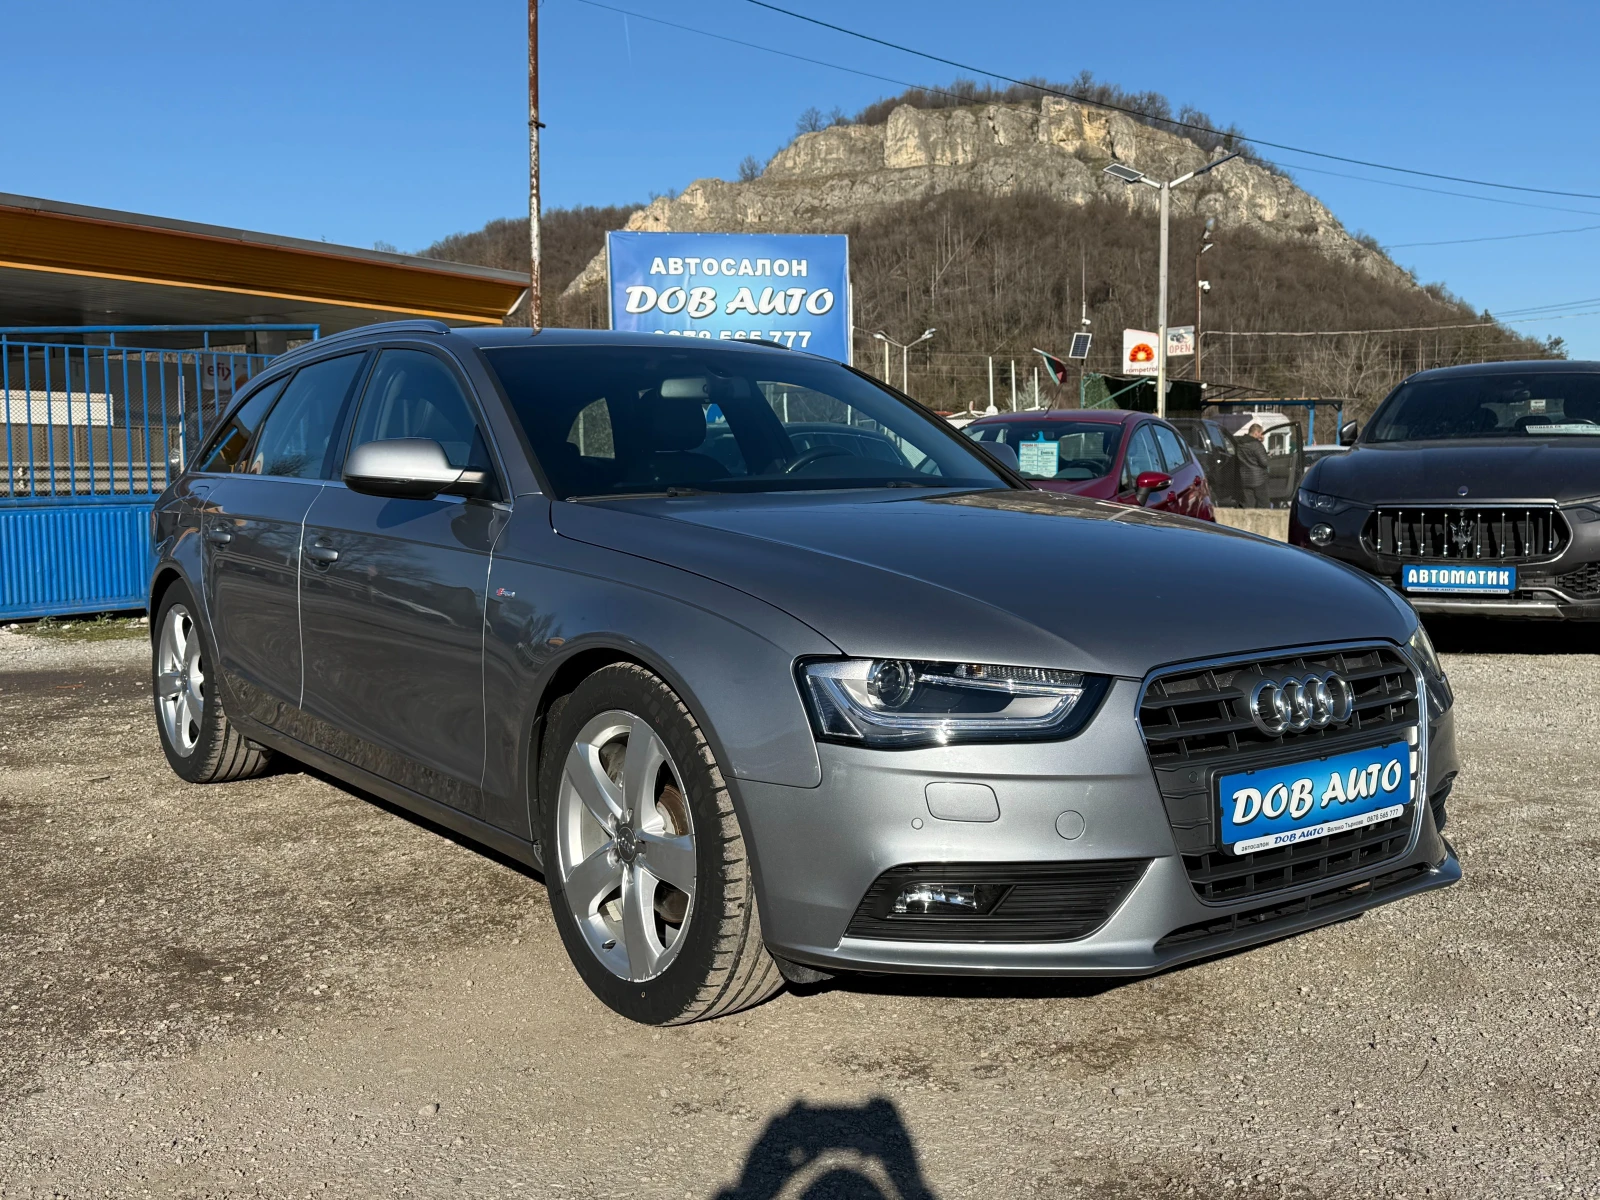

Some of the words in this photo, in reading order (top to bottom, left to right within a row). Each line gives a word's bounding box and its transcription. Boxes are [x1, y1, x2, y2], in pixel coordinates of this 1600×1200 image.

[650, 257, 808, 277] АВТОСАЛОН
[625, 285, 717, 318] DOB
[725, 287, 834, 316] AUTO
[769, 330, 812, 348] 777
[1169, 344, 1191, 354] OPEN
[1125, 366, 1158, 376] rompetrol
[1408, 569, 1510, 586] АВТОМАТИК
[1232, 777, 1314, 827] DOB
[1320, 758, 1402, 810] AUTO
[1241, 841, 1270, 852] автосалон
[1274, 833, 1297, 844] DOB
[1298, 827, 1324, 839] AUTO
[1389, 808, 1399, 817] 777
